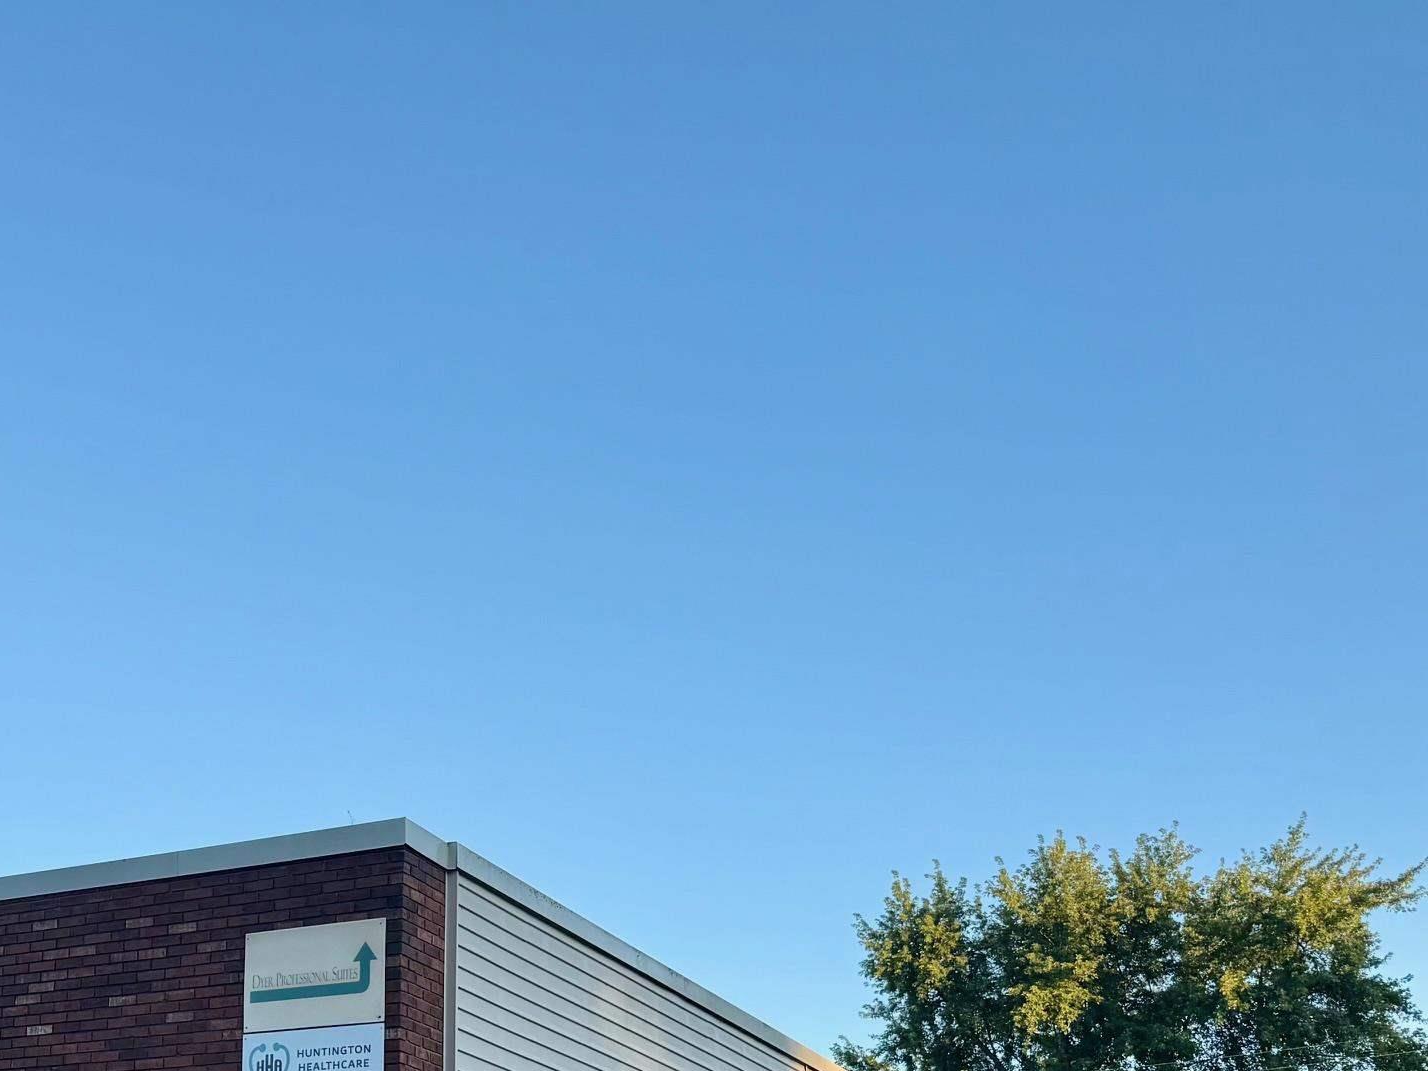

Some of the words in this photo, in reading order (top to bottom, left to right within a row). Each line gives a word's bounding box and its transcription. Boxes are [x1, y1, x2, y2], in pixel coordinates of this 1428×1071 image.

[252, 974, 273, 989] DYER
[276, 971, 329, 987] PROFESSIONAL
[332, 966, 358, 980] SUITES
[297, 1044, 371, 1058] HUNTINGTON
[298, 1059, 370, 1071] HEALTHCARE
